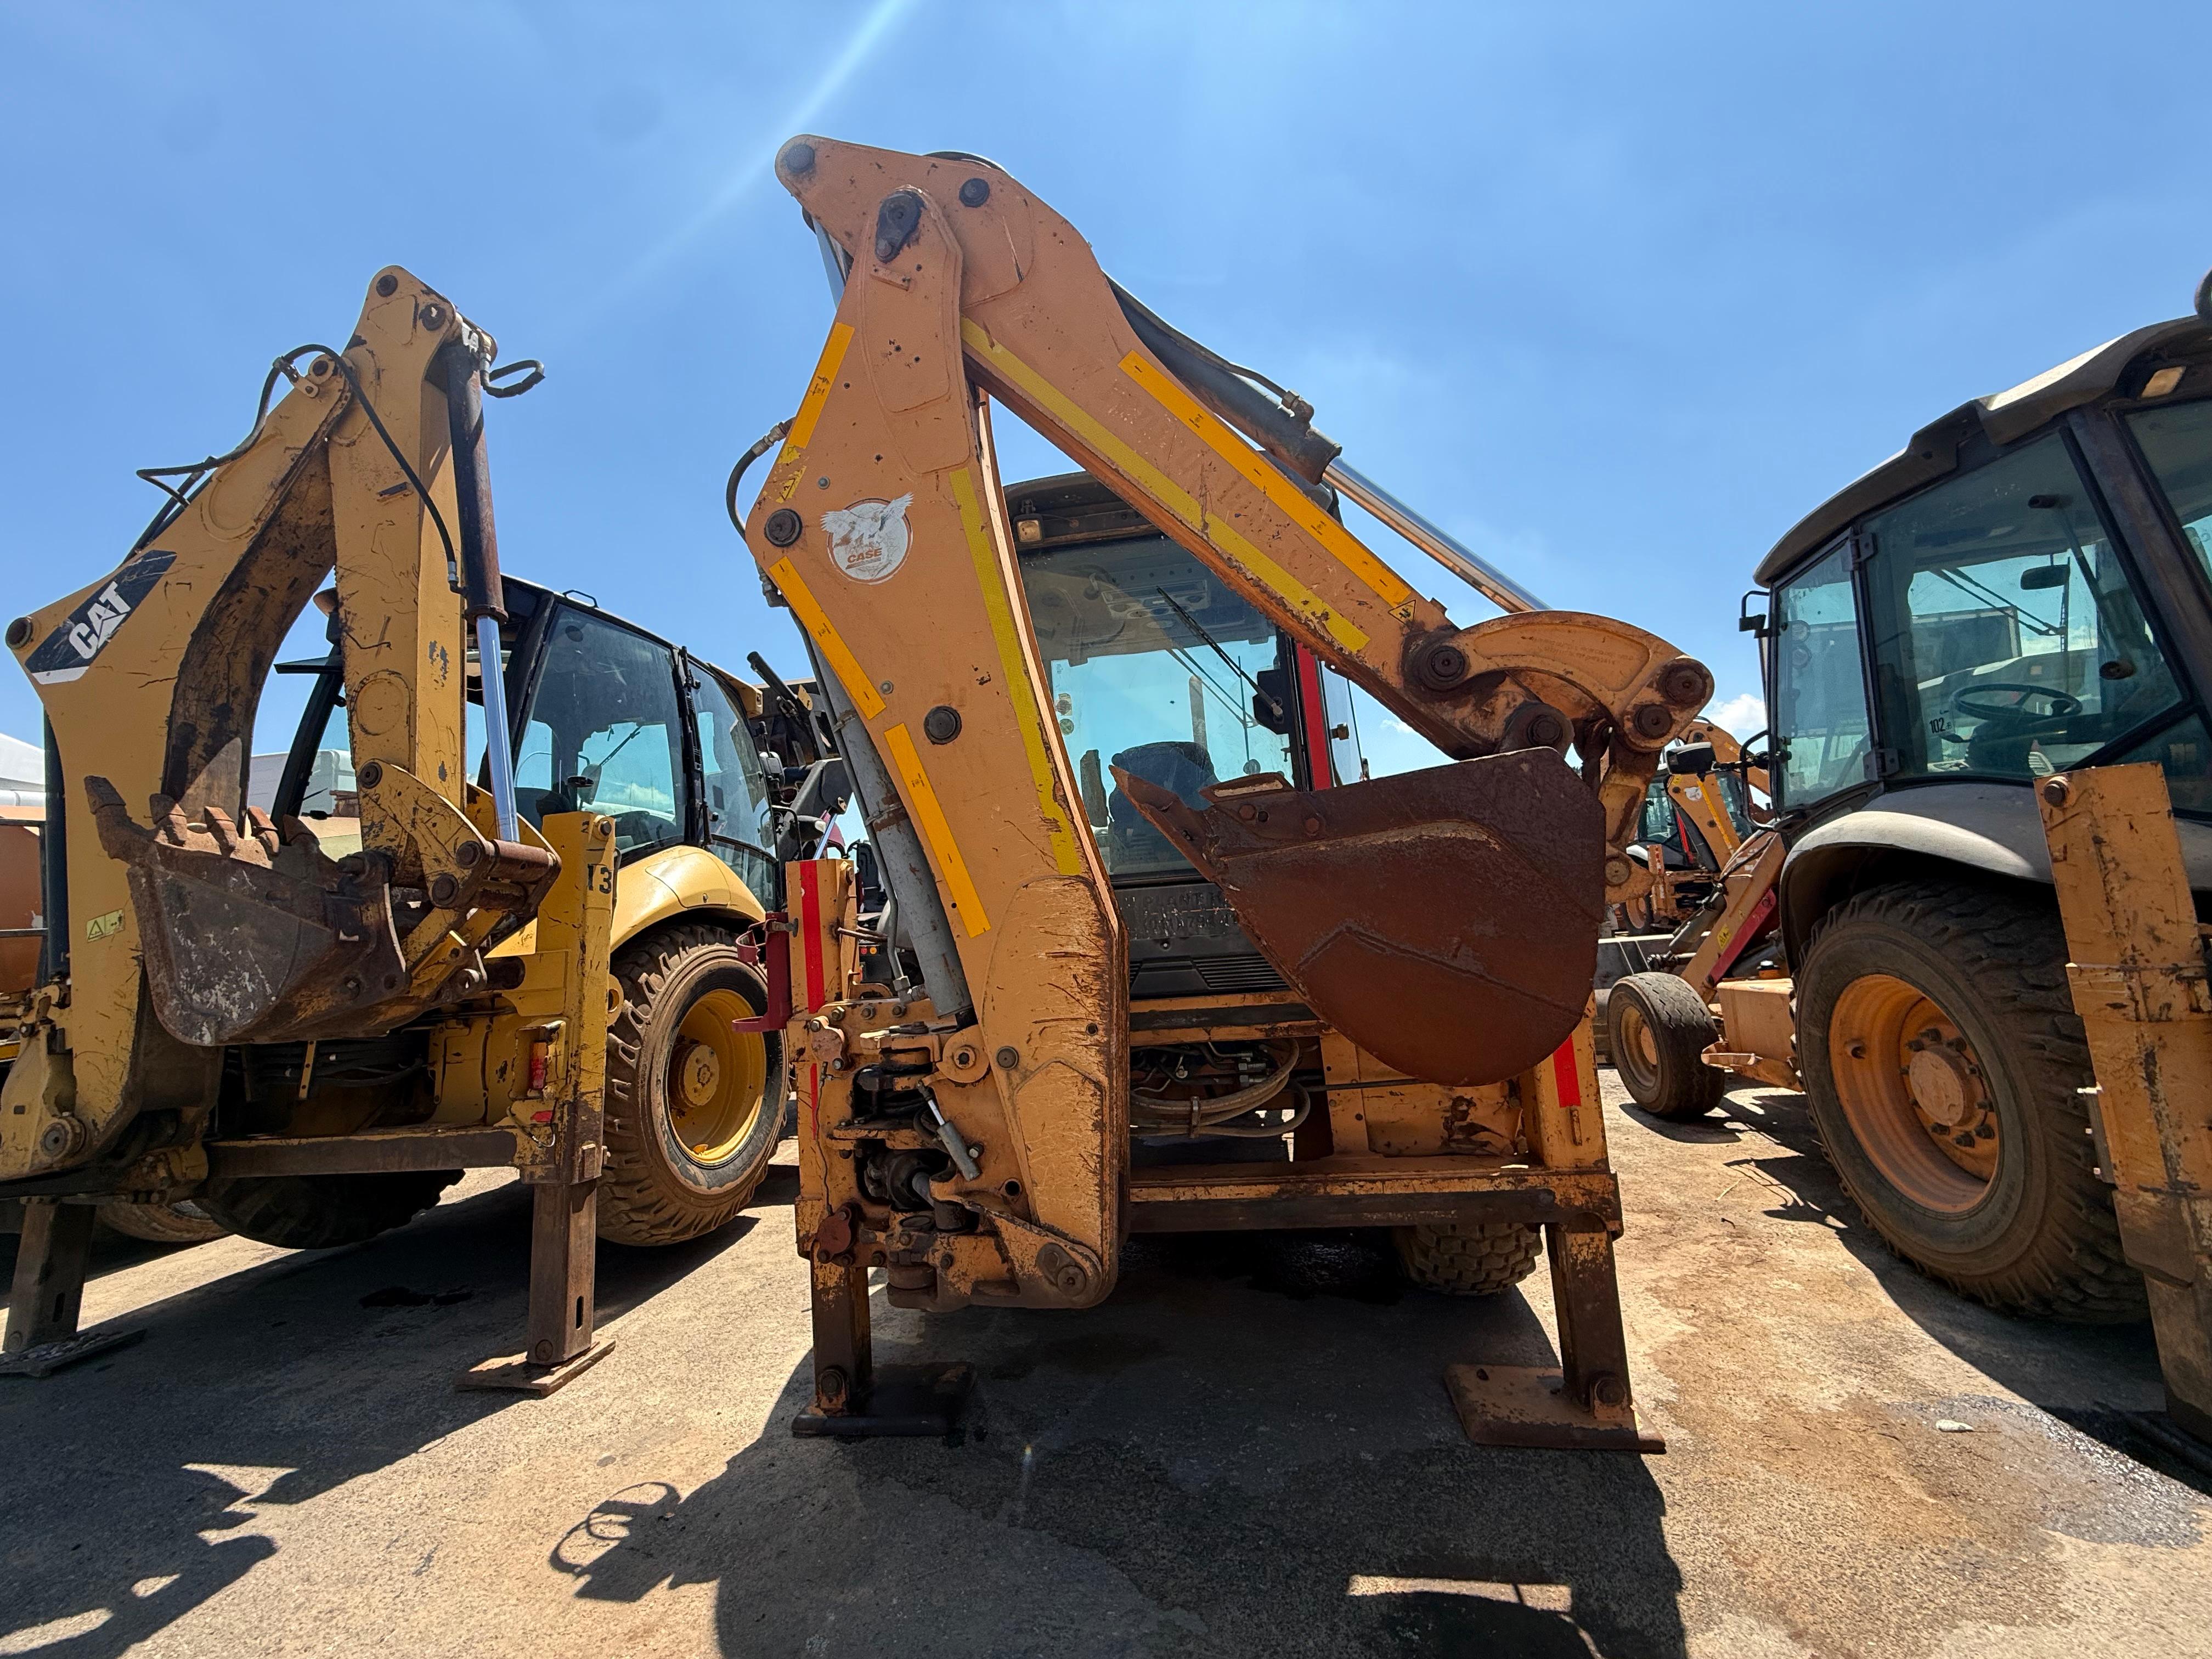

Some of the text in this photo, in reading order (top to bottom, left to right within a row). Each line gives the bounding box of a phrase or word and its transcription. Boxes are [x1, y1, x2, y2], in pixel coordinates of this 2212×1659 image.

[847, 548, 883, 563] CASE
[69, 581, 131, 659] CAT
[1929, 717, 1946, 733] 102
